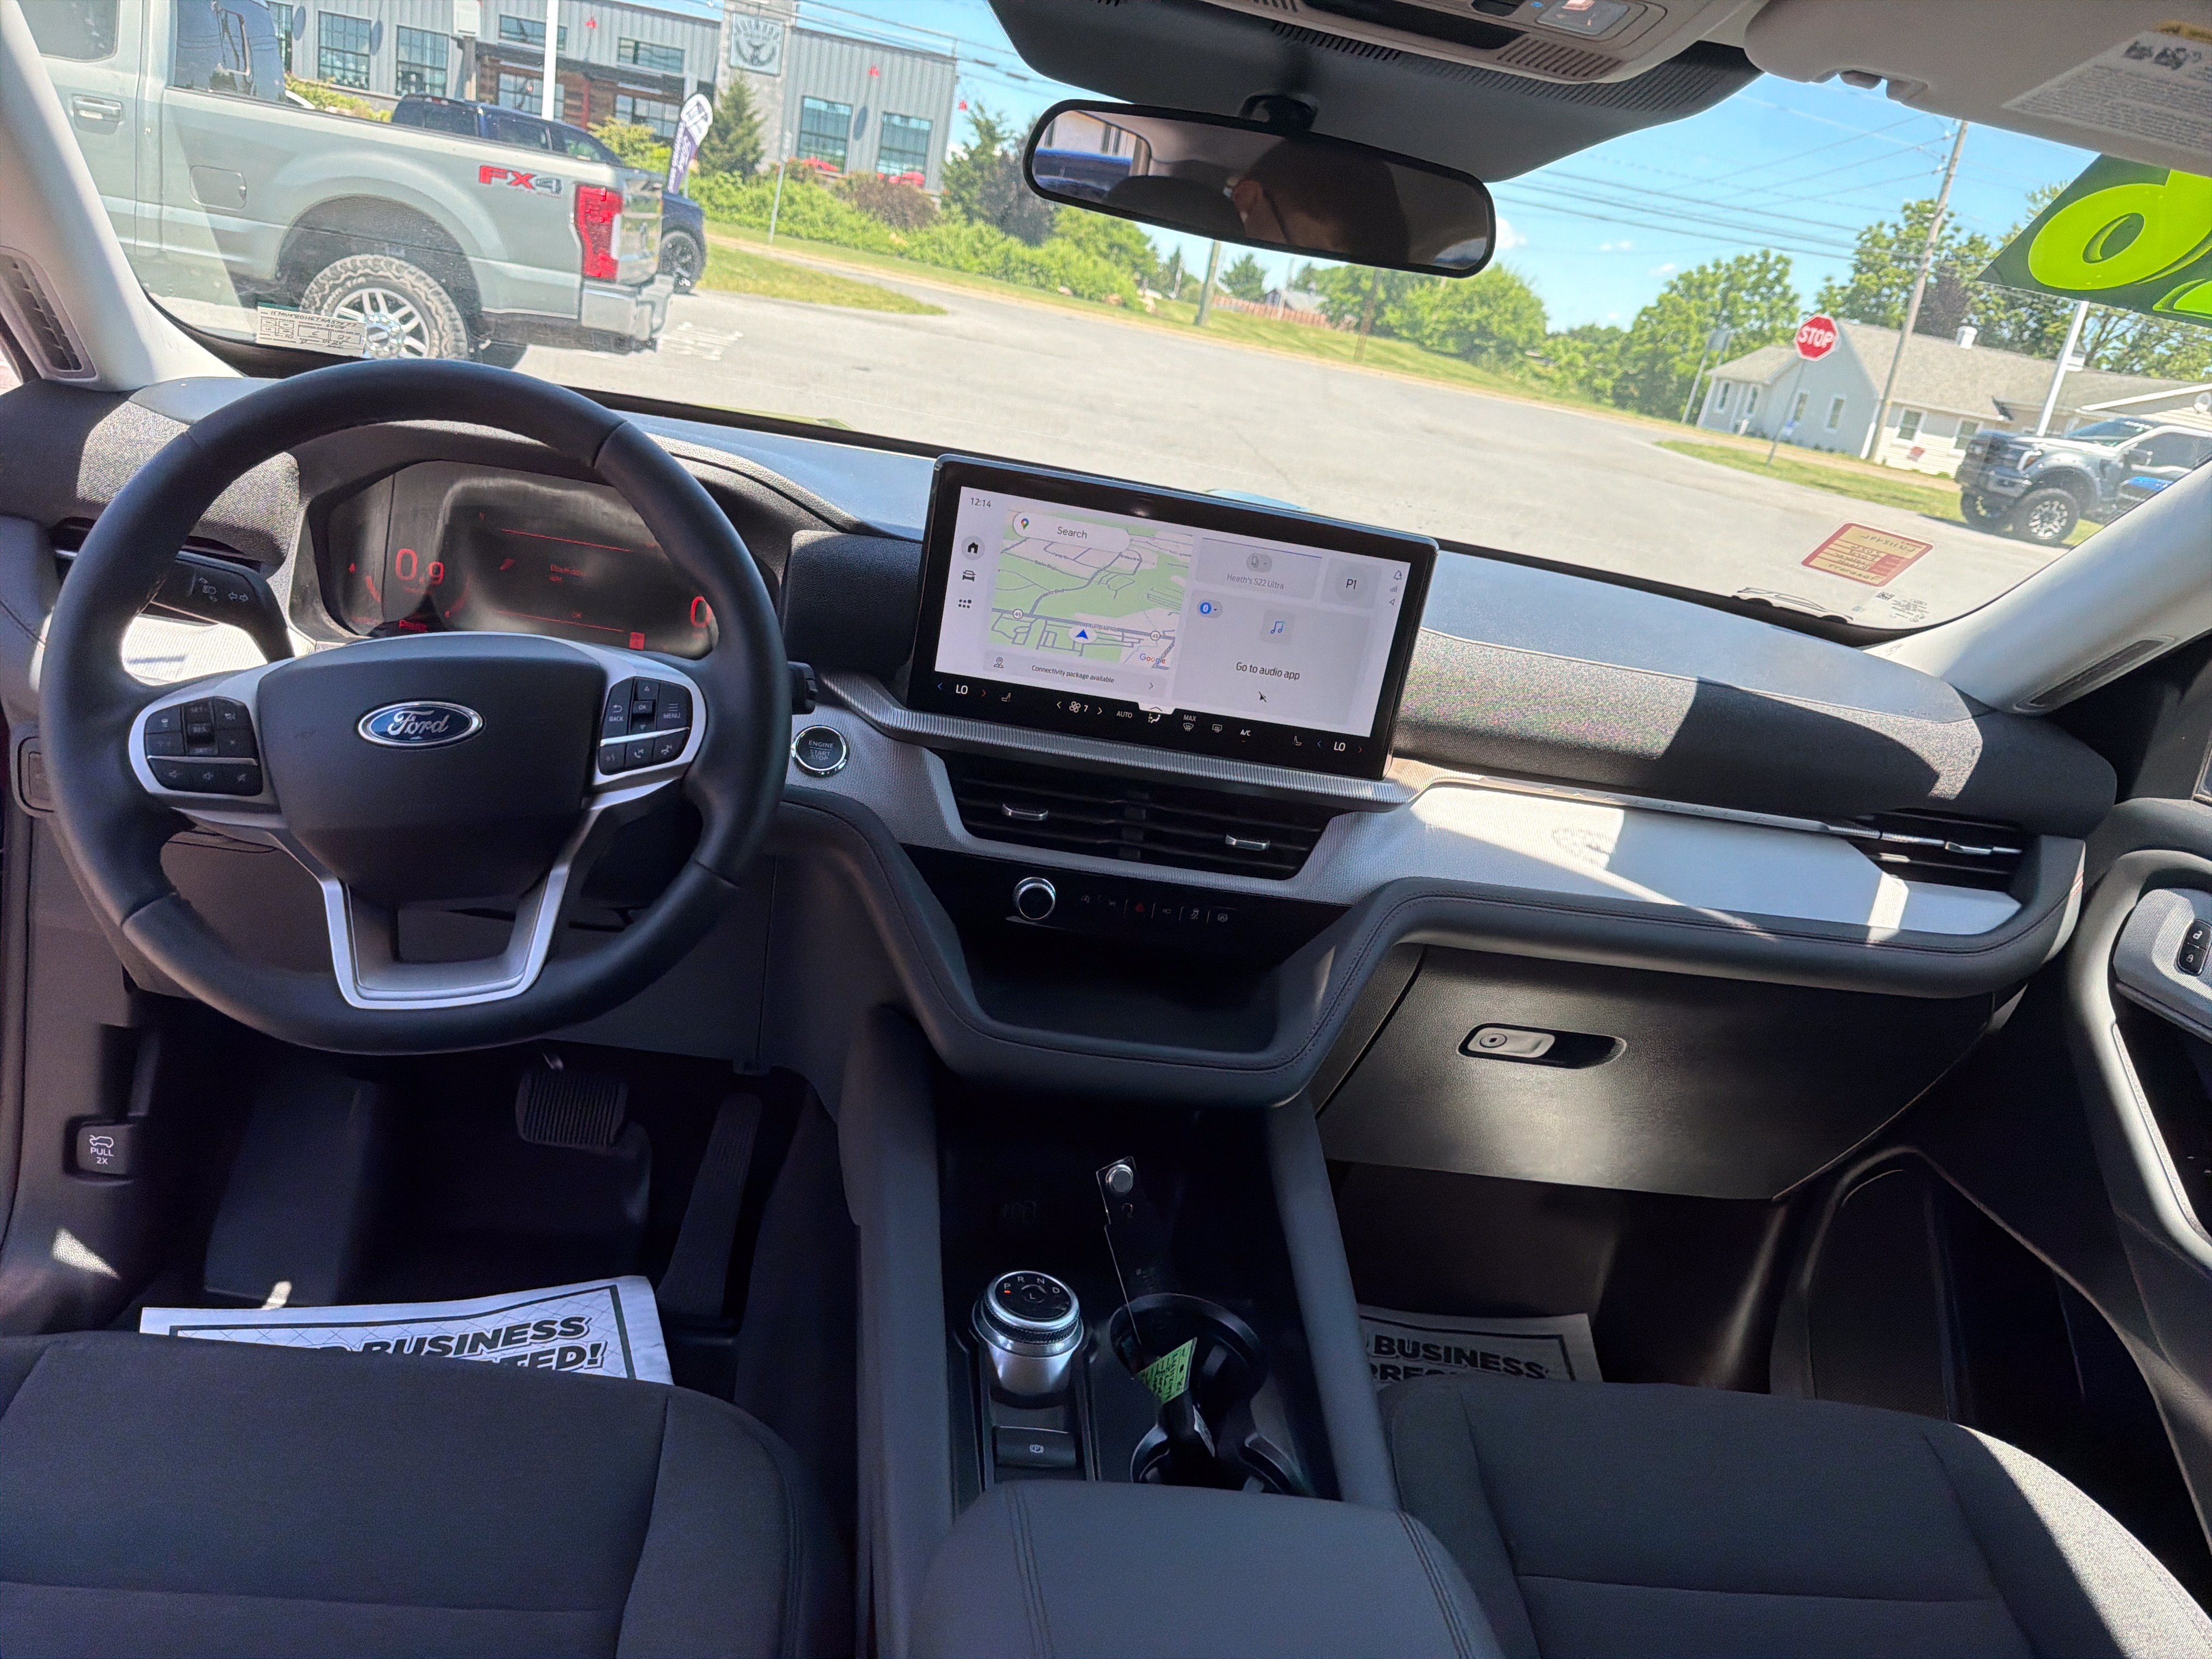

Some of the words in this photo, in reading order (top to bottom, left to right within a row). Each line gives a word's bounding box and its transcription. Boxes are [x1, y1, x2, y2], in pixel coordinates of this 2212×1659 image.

[479, 166, 562, 194] FX4
[1797, 326, 1834, 348] STOP
[970, 497, 991, 508] 12:14
[1057, 526, 1088, 539] Search
[395, 548, 445, 585] 0.9
[1227, 573, 1251, 585] Heath's
[1254, 578, 1266, 587] S22
[1267, 579, 1284, 590] Ultra
[1346, 578, 1357, 590] P1
[1139, 653, 1166, 664] Google
[1031, 665, 1065, 676] Connectivity
[1066, 670, 1088, 681] package
[1090, 674, 1114, 684] available
[1236, 662, 1247, 672] Go
[1249, 664, 1258, 674] to
[1259, 666, 1282, 678] audio
[1284, 671, 1300, 681] app
[956, 684, 968, 695] LO
[1116, 710, 1133, 719] AUTO
[387, 710, 450, 735] Ford
[808, 740, 834, 748] ENGINE
[1333, 741, 1346, 752] LO
[90, 1147, 114, 1157] PULL
[96, 1157, 109, 1165] 2X
[1373, 1334, 1547, 1380] BUSINESS
